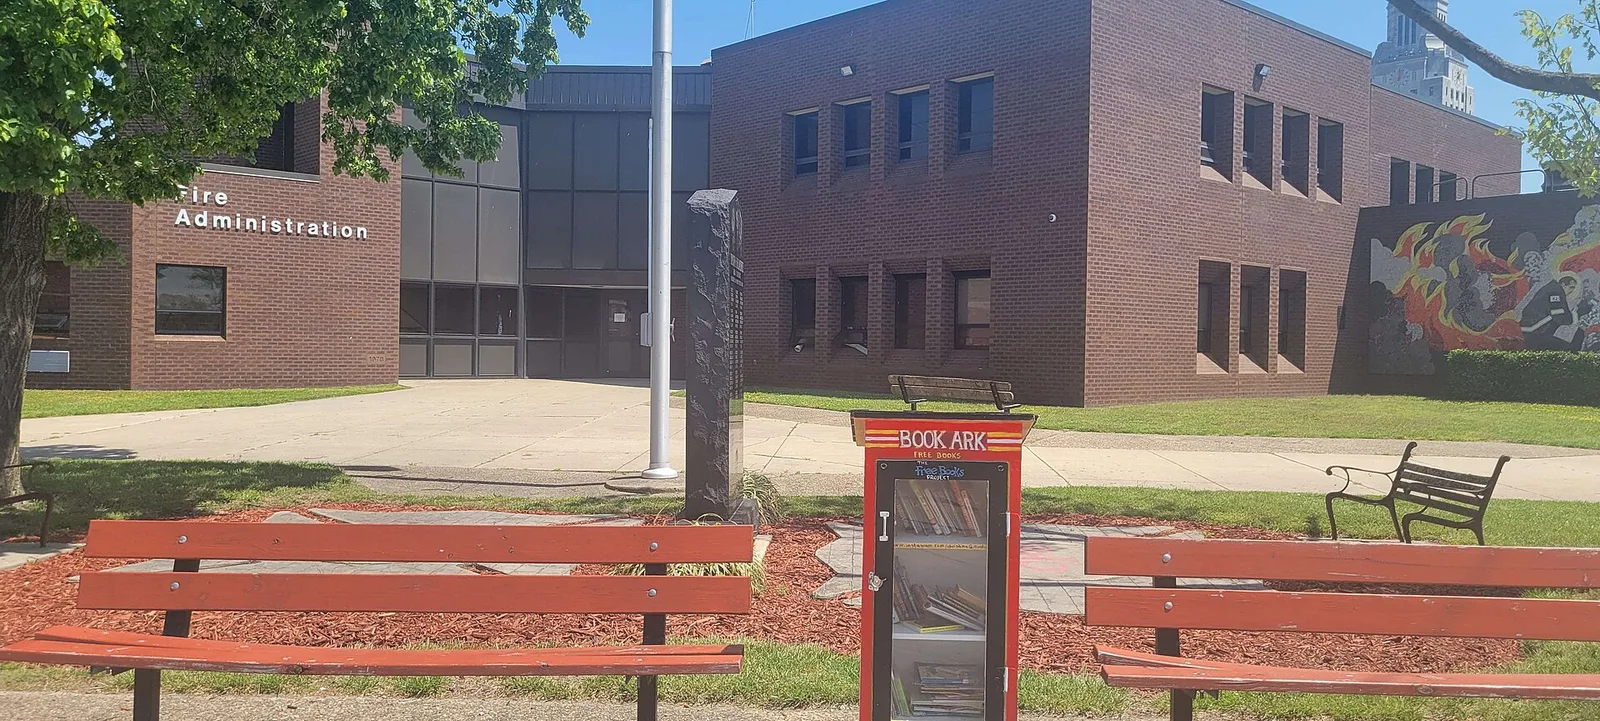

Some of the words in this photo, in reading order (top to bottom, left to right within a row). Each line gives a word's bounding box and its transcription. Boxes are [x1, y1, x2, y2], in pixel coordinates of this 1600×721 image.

[174, 208, 368, 239] Administration
[899, 429, 947, 449] BOOK
[949, 431, 987, 451] ARK
[913, 451, 933, 459] FREE
[936, 451, 961, 459] BOOKS
